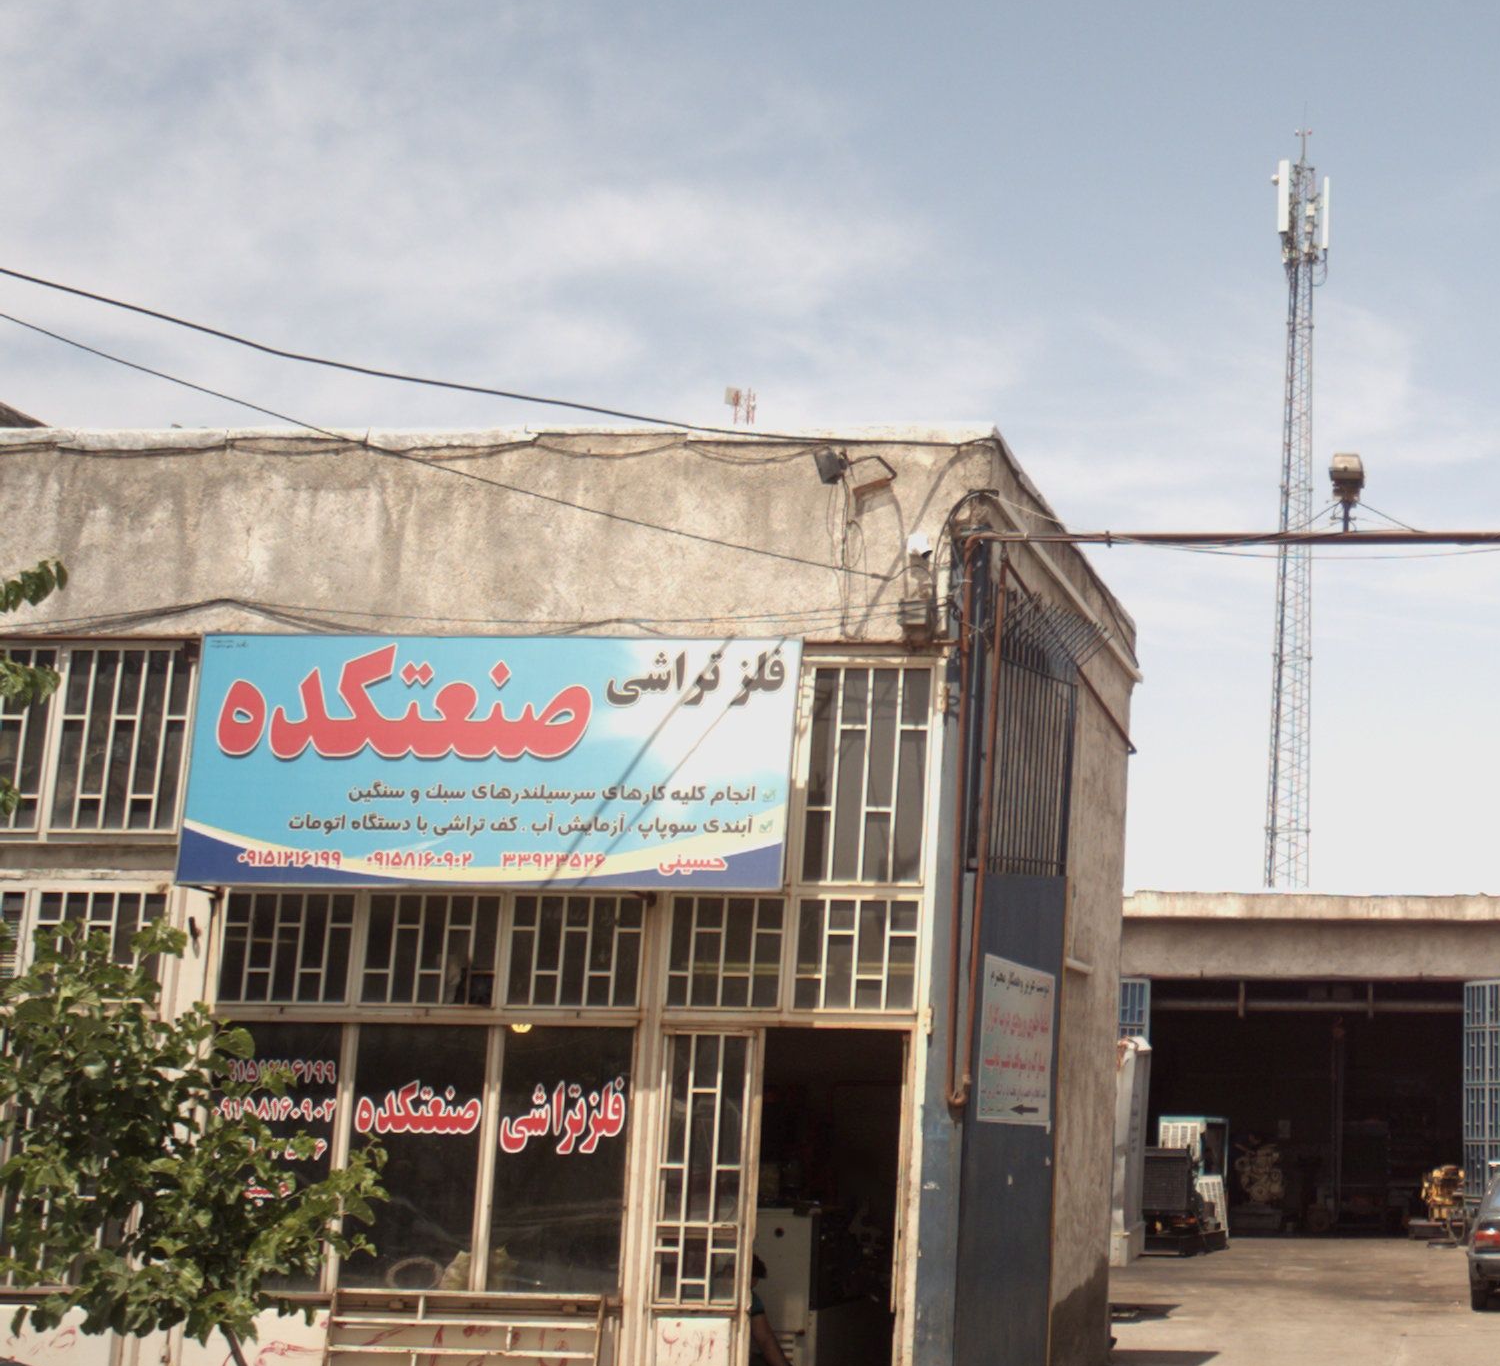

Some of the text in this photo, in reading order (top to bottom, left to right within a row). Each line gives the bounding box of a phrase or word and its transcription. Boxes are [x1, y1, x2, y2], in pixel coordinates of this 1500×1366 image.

[606, 648, 786, 707] فلز تراشی
[216, 643, 593, 760] صنعتکده
[348, 781, 405, 803] سنگین
[410, 788, 420, 804] و
[471, 783, 596, 805] سرسیلندرهای
[601, 784, 665, 806] کارهای
[670, 785, 706, 804] کلیه
[710, 785, 756, 806] انجام
[288, 812, 347, 835] اتومات
[350, 813, 412, 832] دستگاه
[416, 814, 429, 835] با
[433, 814, 486, 836] تراشی
[490, 815, 518, 832] کف
[531, 813, 553, 835] آب
[238, 848, 343, 867] ۰۹۱۵۱۲۱۶۱۹۹
[366, 850, 474, 868] ۰۹۱۵۸۱۶۰۹۰۲
[658, 853, 728, 877] حسینی
[216, 1059, 336, 1084] ۹۱۵۲۶۱۹۹
[354, 1079, 482, 1135] صنعتکده
